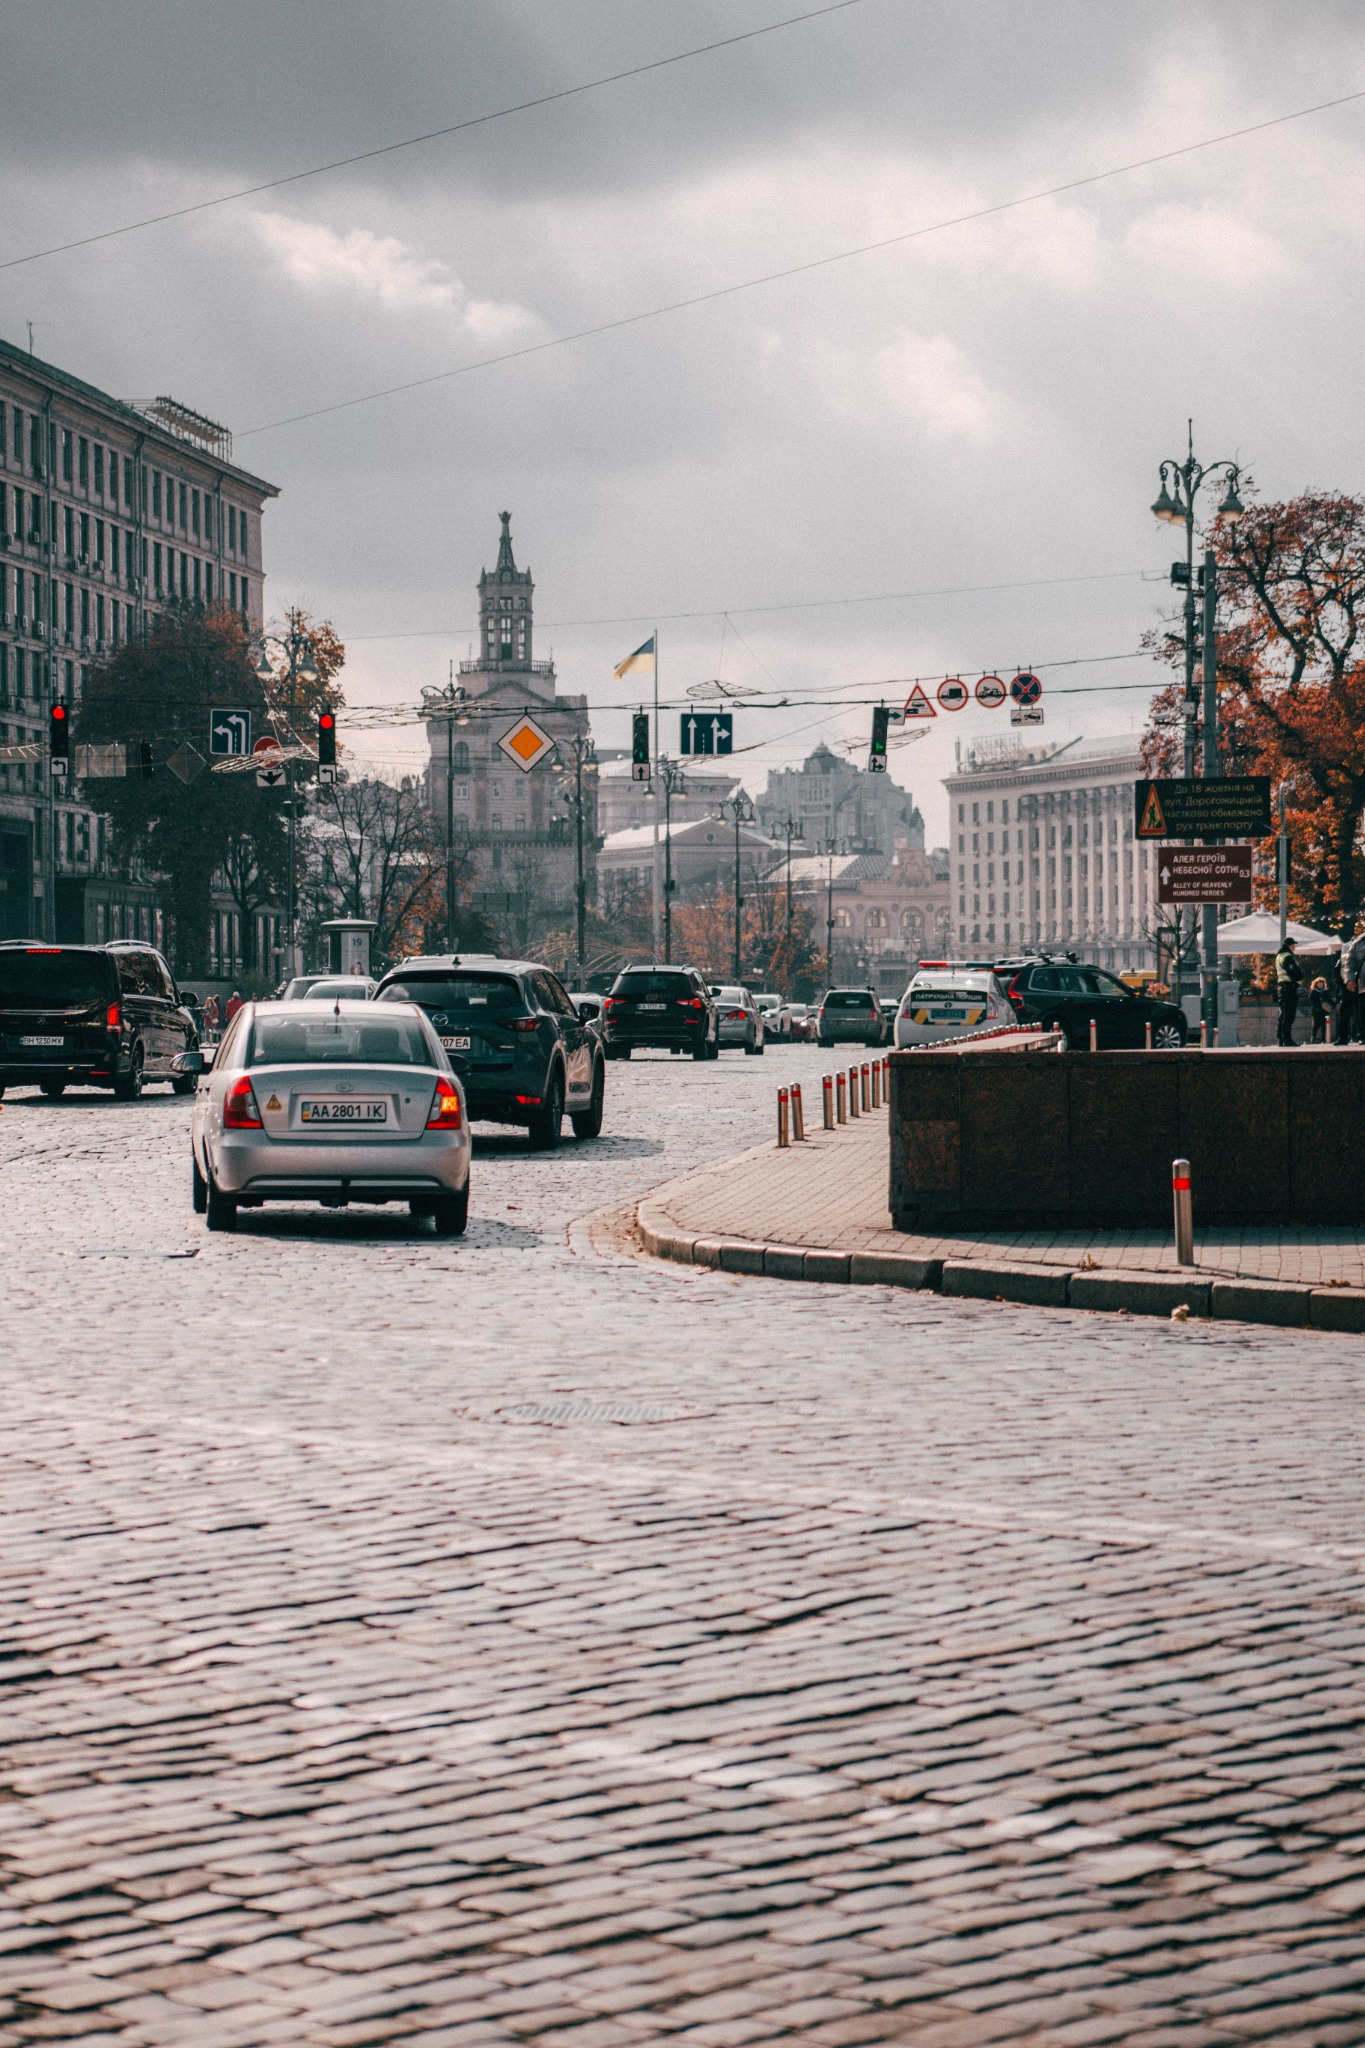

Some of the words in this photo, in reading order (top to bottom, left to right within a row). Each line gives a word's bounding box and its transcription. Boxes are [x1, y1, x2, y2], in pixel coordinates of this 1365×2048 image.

[1174, 785, 1188, 794] До
[1191, 784, 1202, 793] 18
[1204, 784, 1240, 793] жовтня
[1242, 783, 1255, 792] на
[1211, 808, 1263, 817] обмежено
[1175, 822, 1193, 832] рух
[1195, 821, 1253, 832] транспорту
[1173, 855, 1194, 863] АЛЕЯ
[1196, 853, 1226, 863] ГЕРОЇВ
[1173, 864, 1213, 874] НЕБЕСНОЇ
[1215, 865, 1239, 874] СОТНІ
[24, 1037, 35, 1045] BH
[36, 1037, 51, 1045] 1230
[52, 1037, 62, 1045] MX
[455, 1038, 469, 1047] EA
[311, 1105, 330, 1117] AA
[332, 1105, 361, 1117] 2801
